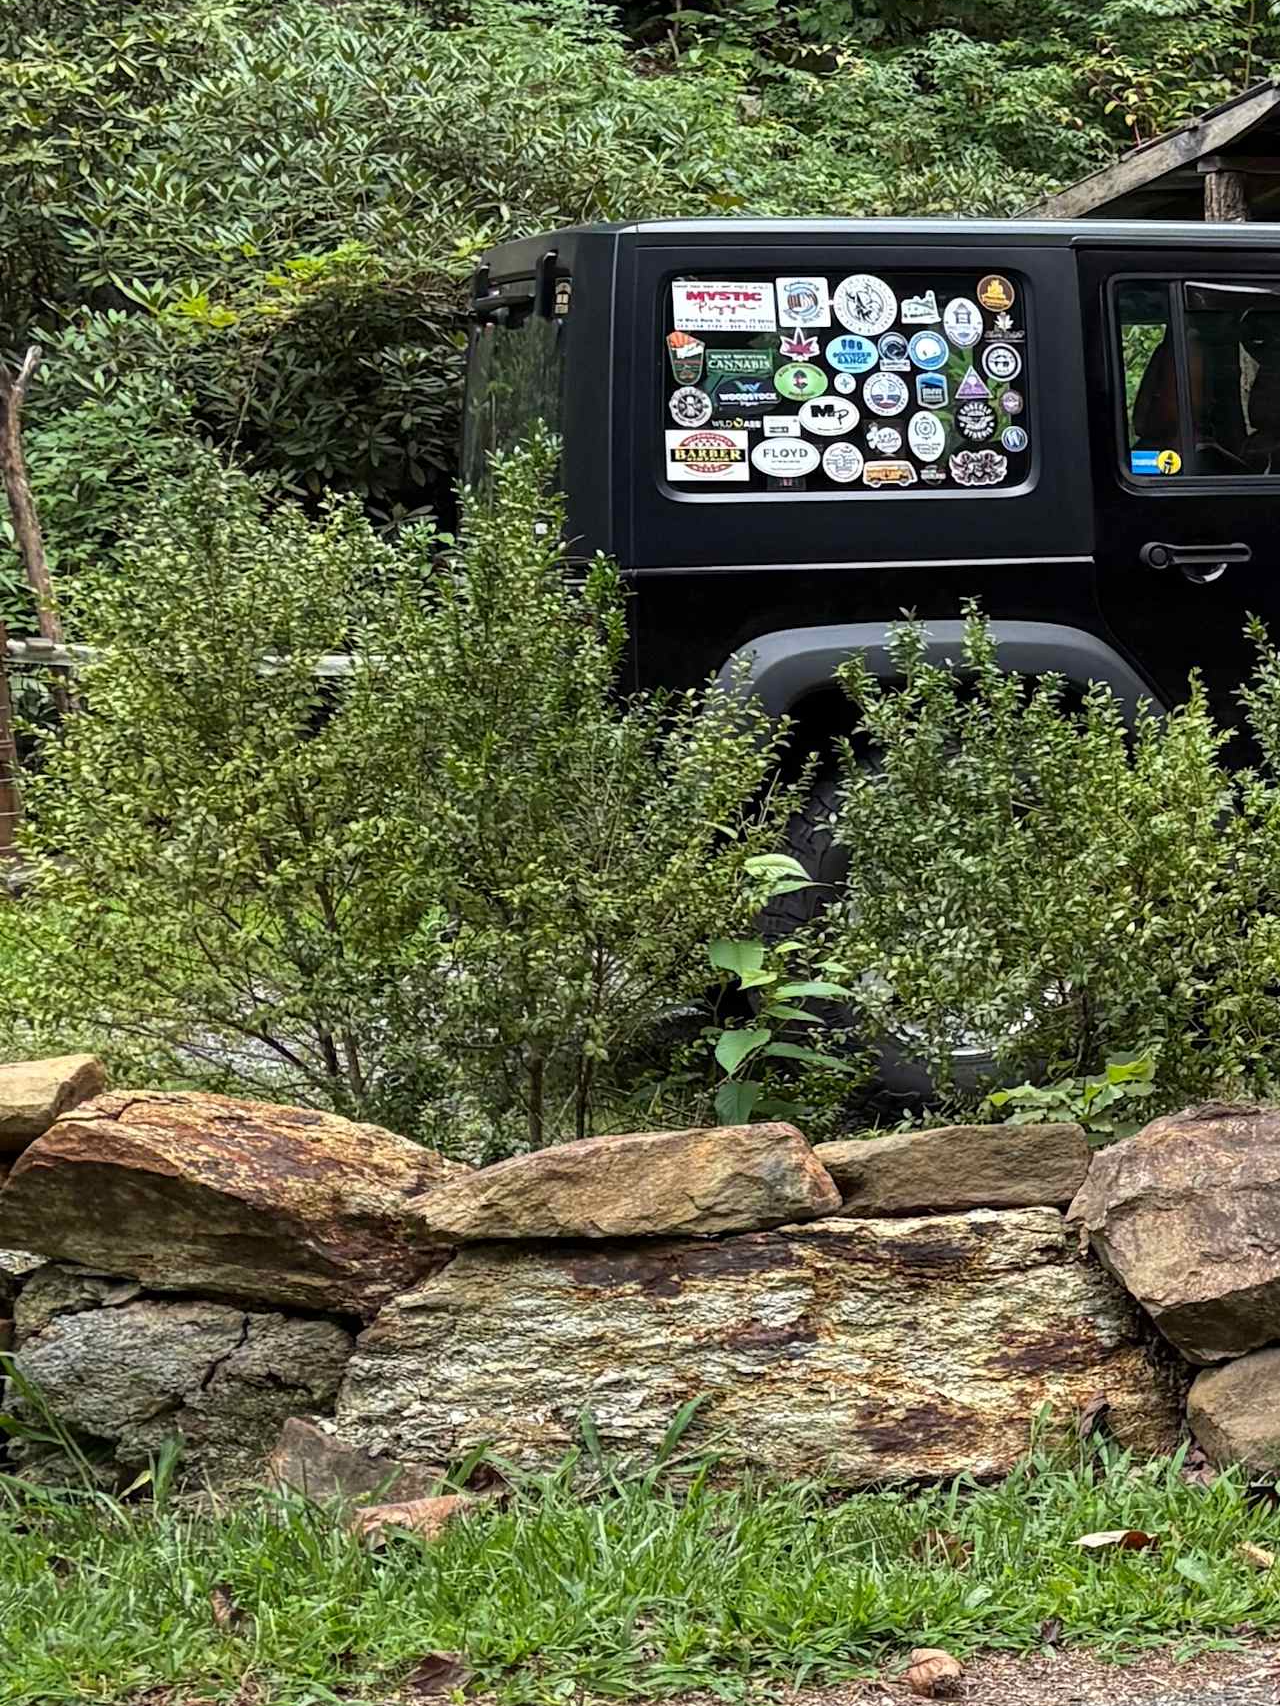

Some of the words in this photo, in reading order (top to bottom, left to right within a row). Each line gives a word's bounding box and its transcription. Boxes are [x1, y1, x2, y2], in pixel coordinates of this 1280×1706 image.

[686, 291, 762, 301] MYSTIC
[708, 359, 770, 371] CANNABIS
[718, 392, 778, 401] WOODSTOCK
[675, 449, 743, 461] BARBER
[763, 448, 808, 459] FLOYD
